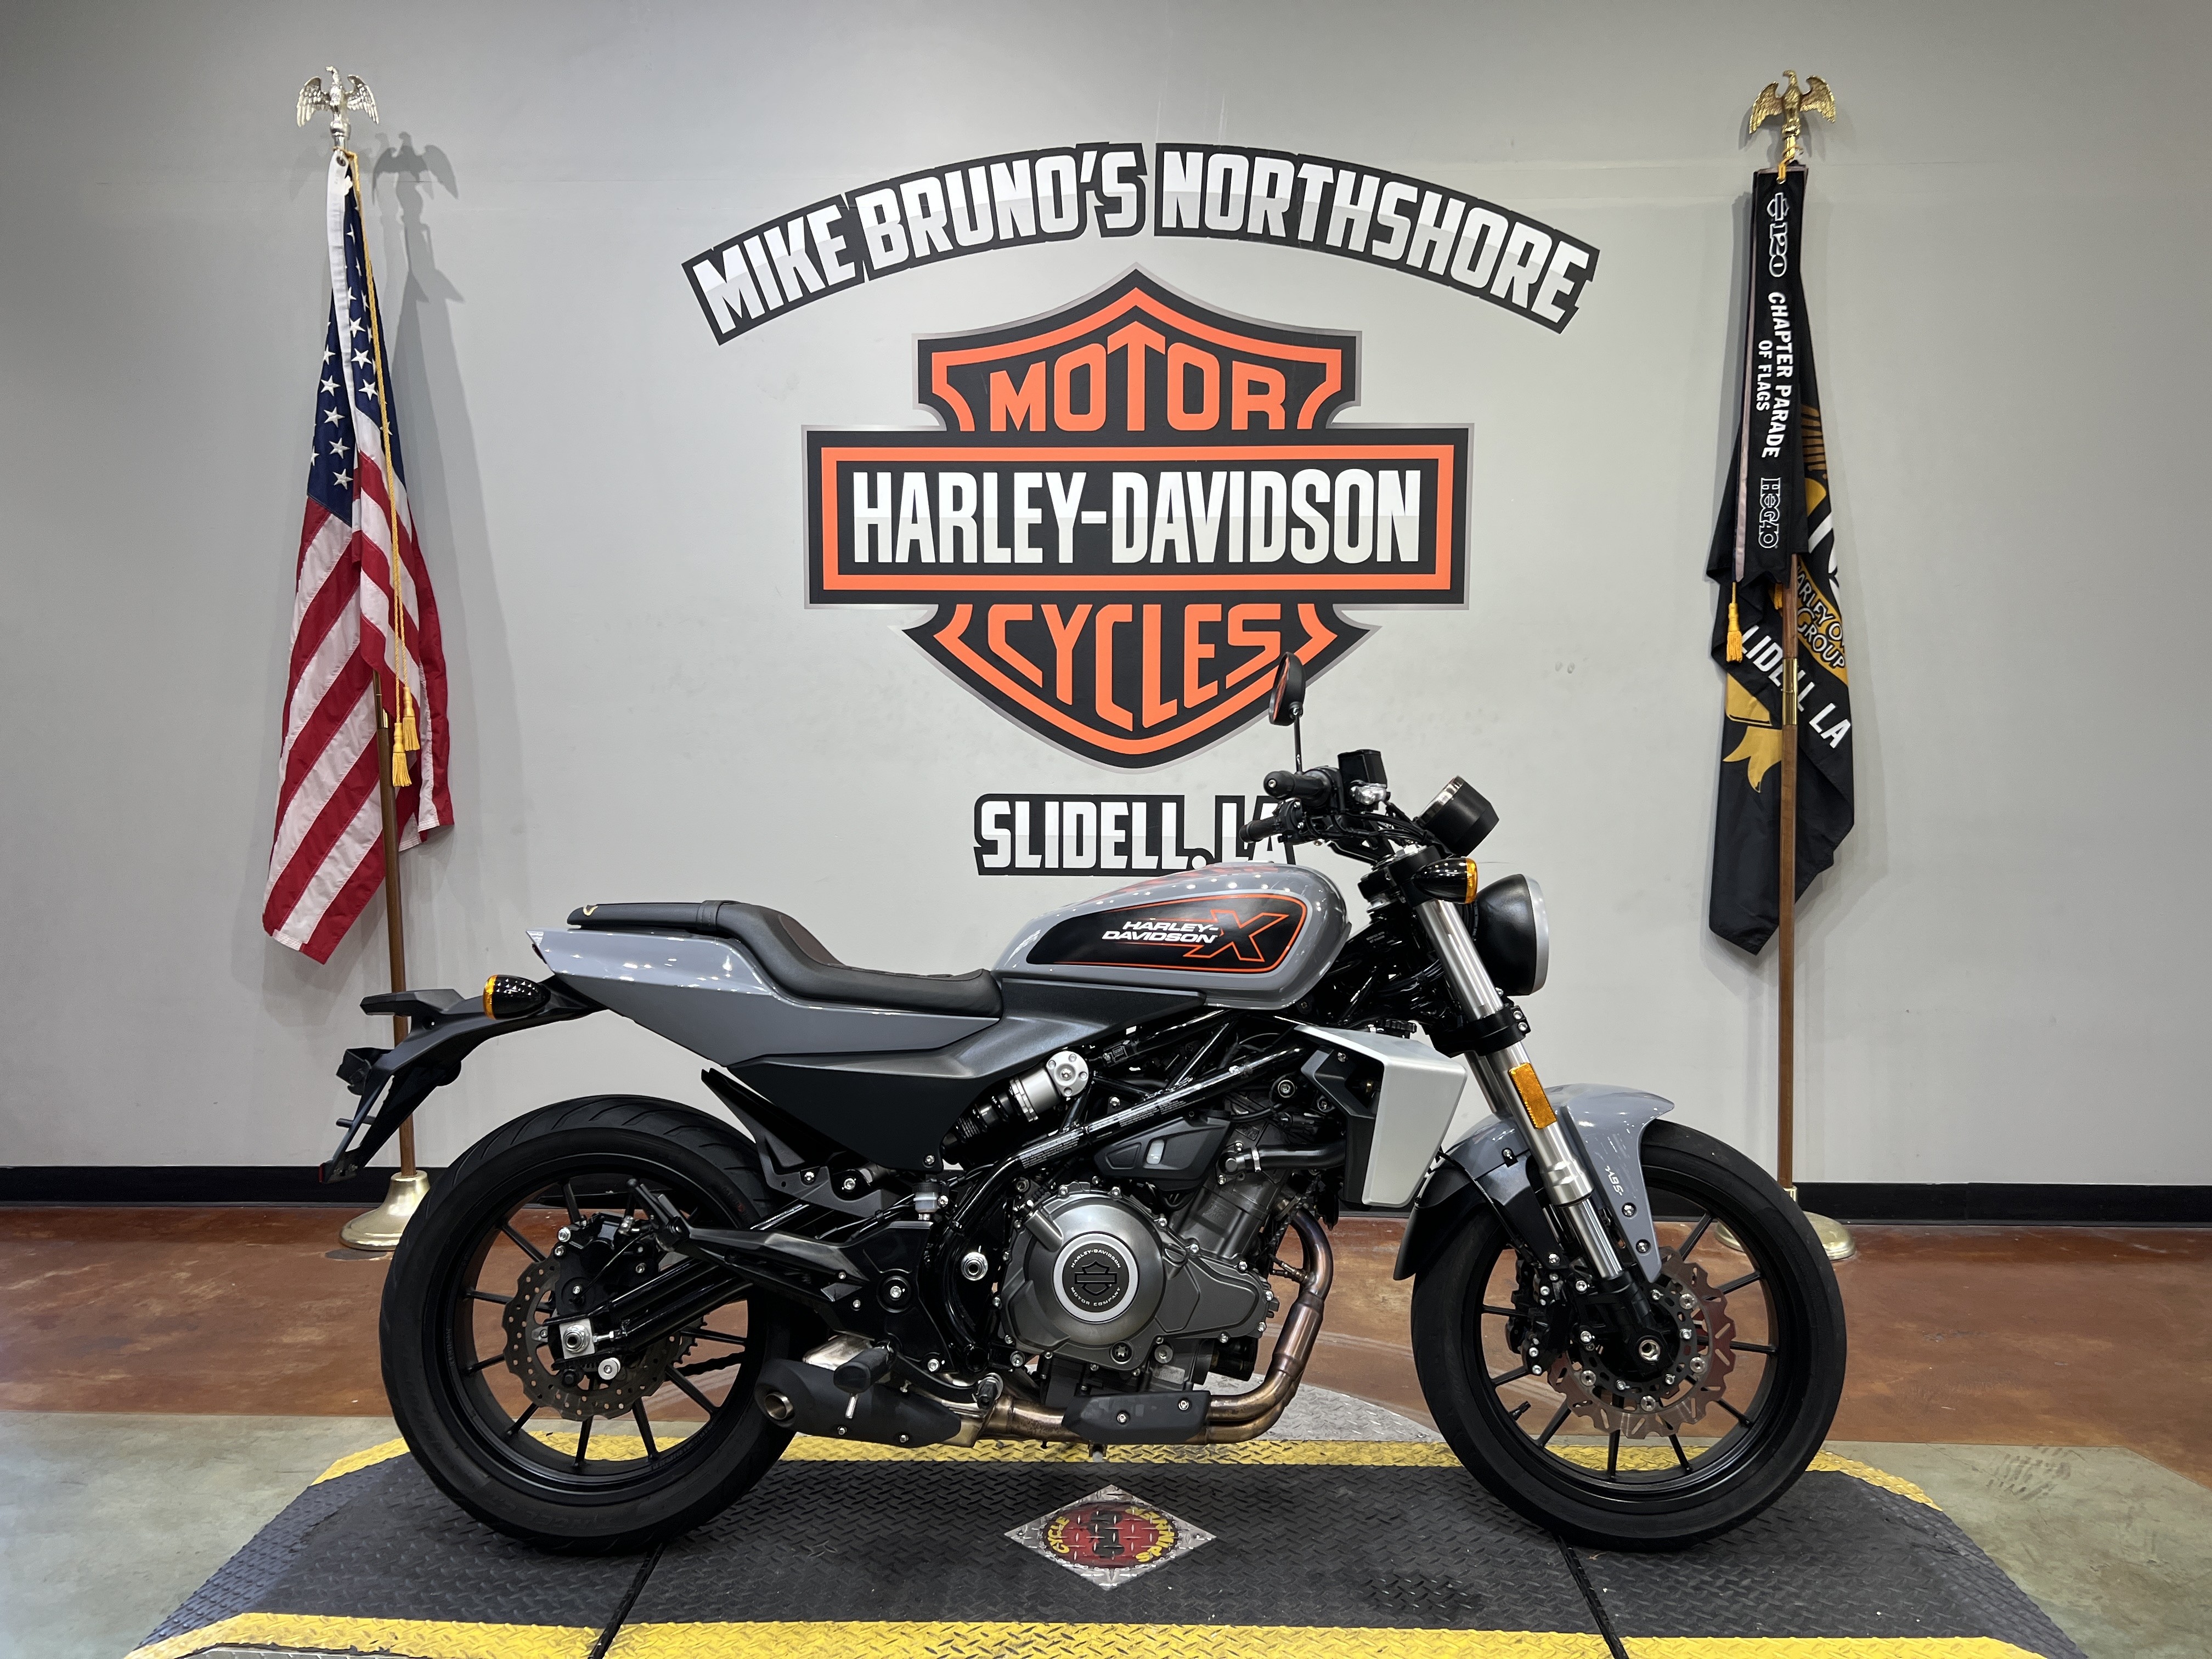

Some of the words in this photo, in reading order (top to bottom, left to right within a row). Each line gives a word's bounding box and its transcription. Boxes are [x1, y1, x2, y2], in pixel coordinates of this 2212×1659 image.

[692, 204, 856, 335] MIKE
[855, 150, 1137, 271] BRUNO'S
[1161, 150, 1589, 324] NORTHSHORE
[1758, 340, 1773, 359] OF
[1768, 291, 1793, 377] CHAPTER
[989, 320, 1286, 432] MOTOR
[1756, 364, 1772, 411] FLAGS
[1762, 385, 1792, 458] PARADE
[853, 468, 1421, 565] HARLEY-DAVIDSON
[1797, 566, 1833, 625] ARLEY
[1797, 607, 1845, 667] GROUP
[987, 603, 1282, 732] CYCLES
[1809, 703, 1851, 749] LA
[1222, 803, 1288, 864] LA
[1102, 931, 1218, 944] DAVIDSON
[1122, 921, 1219, 933] HARLEY-
[1605, 1165, 1624, 1196] ABS
[1071, 1249, 1121, 1268] HARLEY-DAVIDSON
[1071, 1286, 1090, 1305] MOTOR
[1093, 1287, 1120, 1306] COMPANY
[1047, 1516, 1070, 1554] CYCLE
